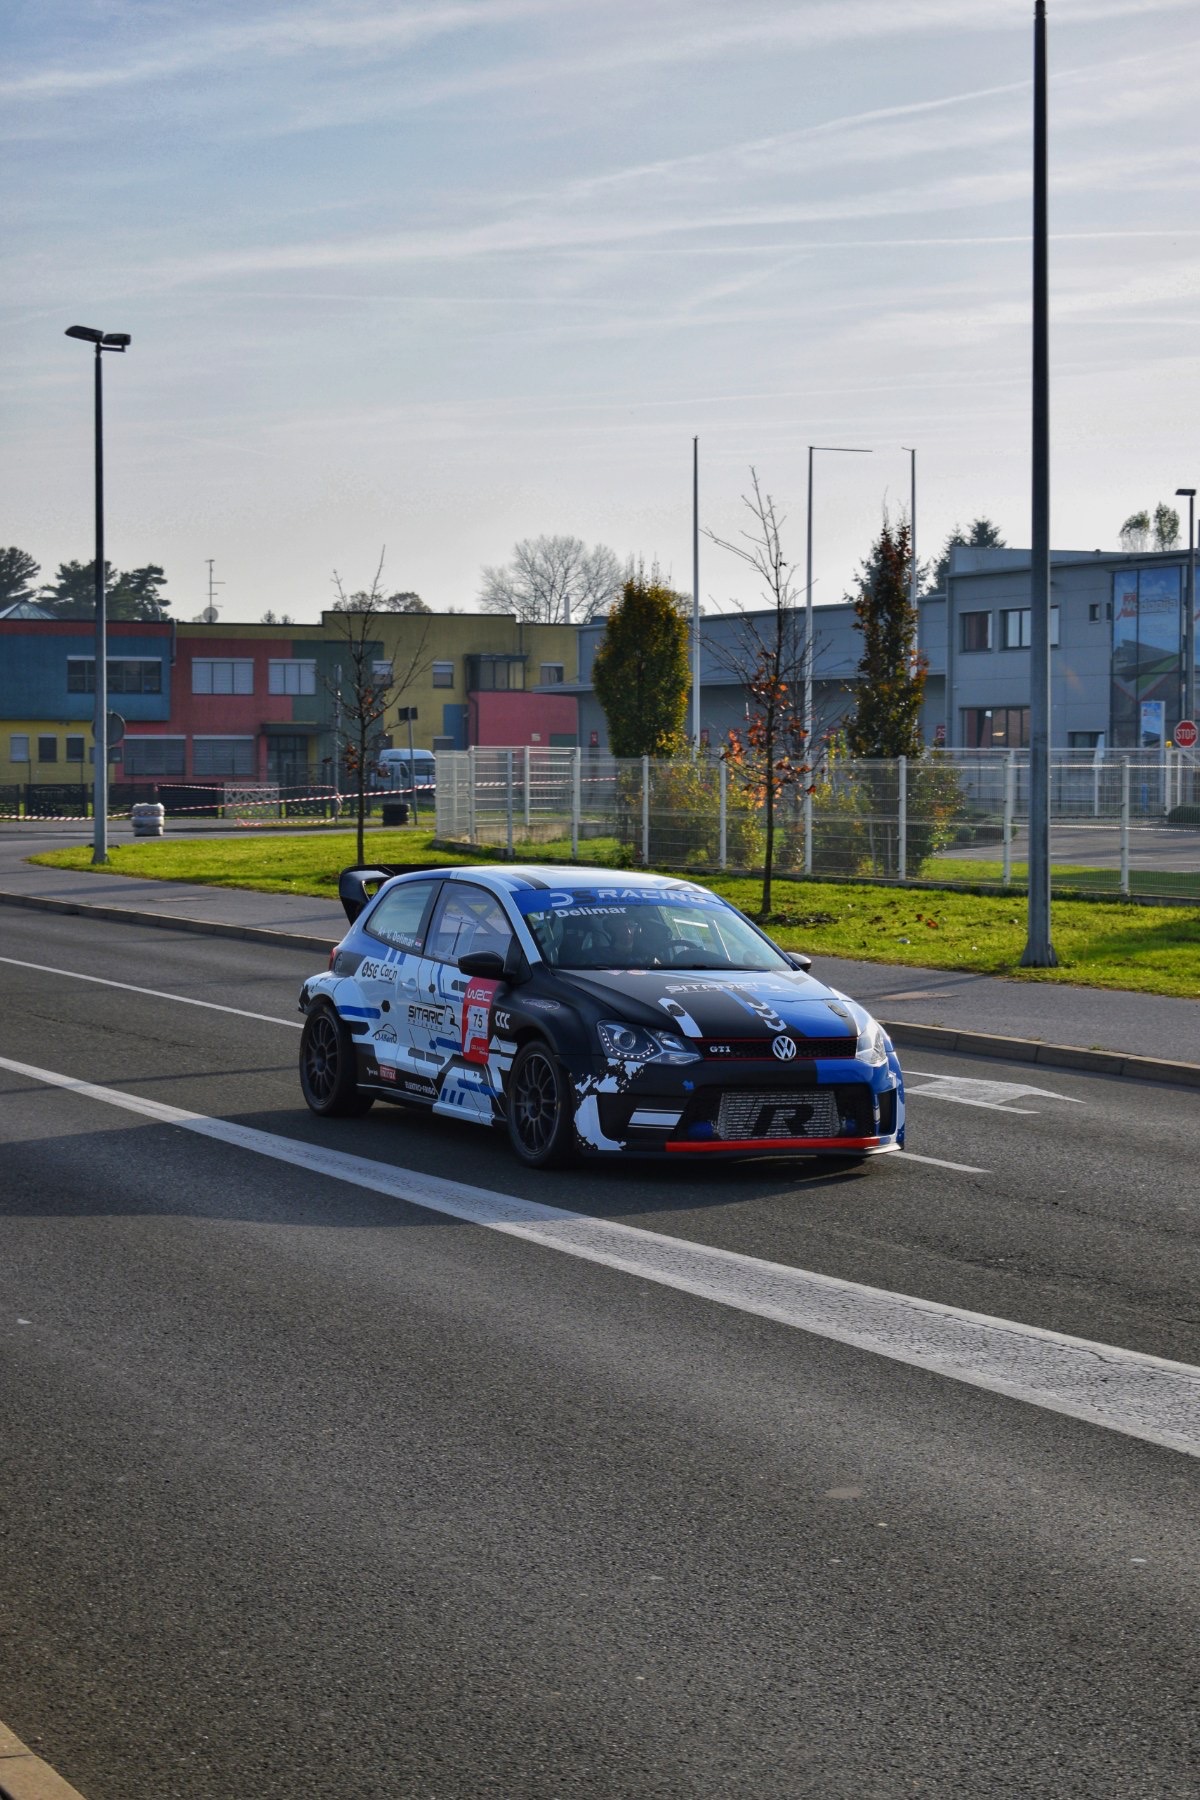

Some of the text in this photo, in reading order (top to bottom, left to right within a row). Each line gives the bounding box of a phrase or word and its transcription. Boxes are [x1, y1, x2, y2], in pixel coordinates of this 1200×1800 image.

[1176, 728, 1196, 740] STOP
[598, 888, 707, 904] RACING
[554, 906, 627, 918] Delimar
[467, 988, 493, 1002] WRC
[408, 1005, 444, 1026] SITARIC
[473, 1013, 483, 1029] 75
[709, 1045, 731, 1053] GTI
